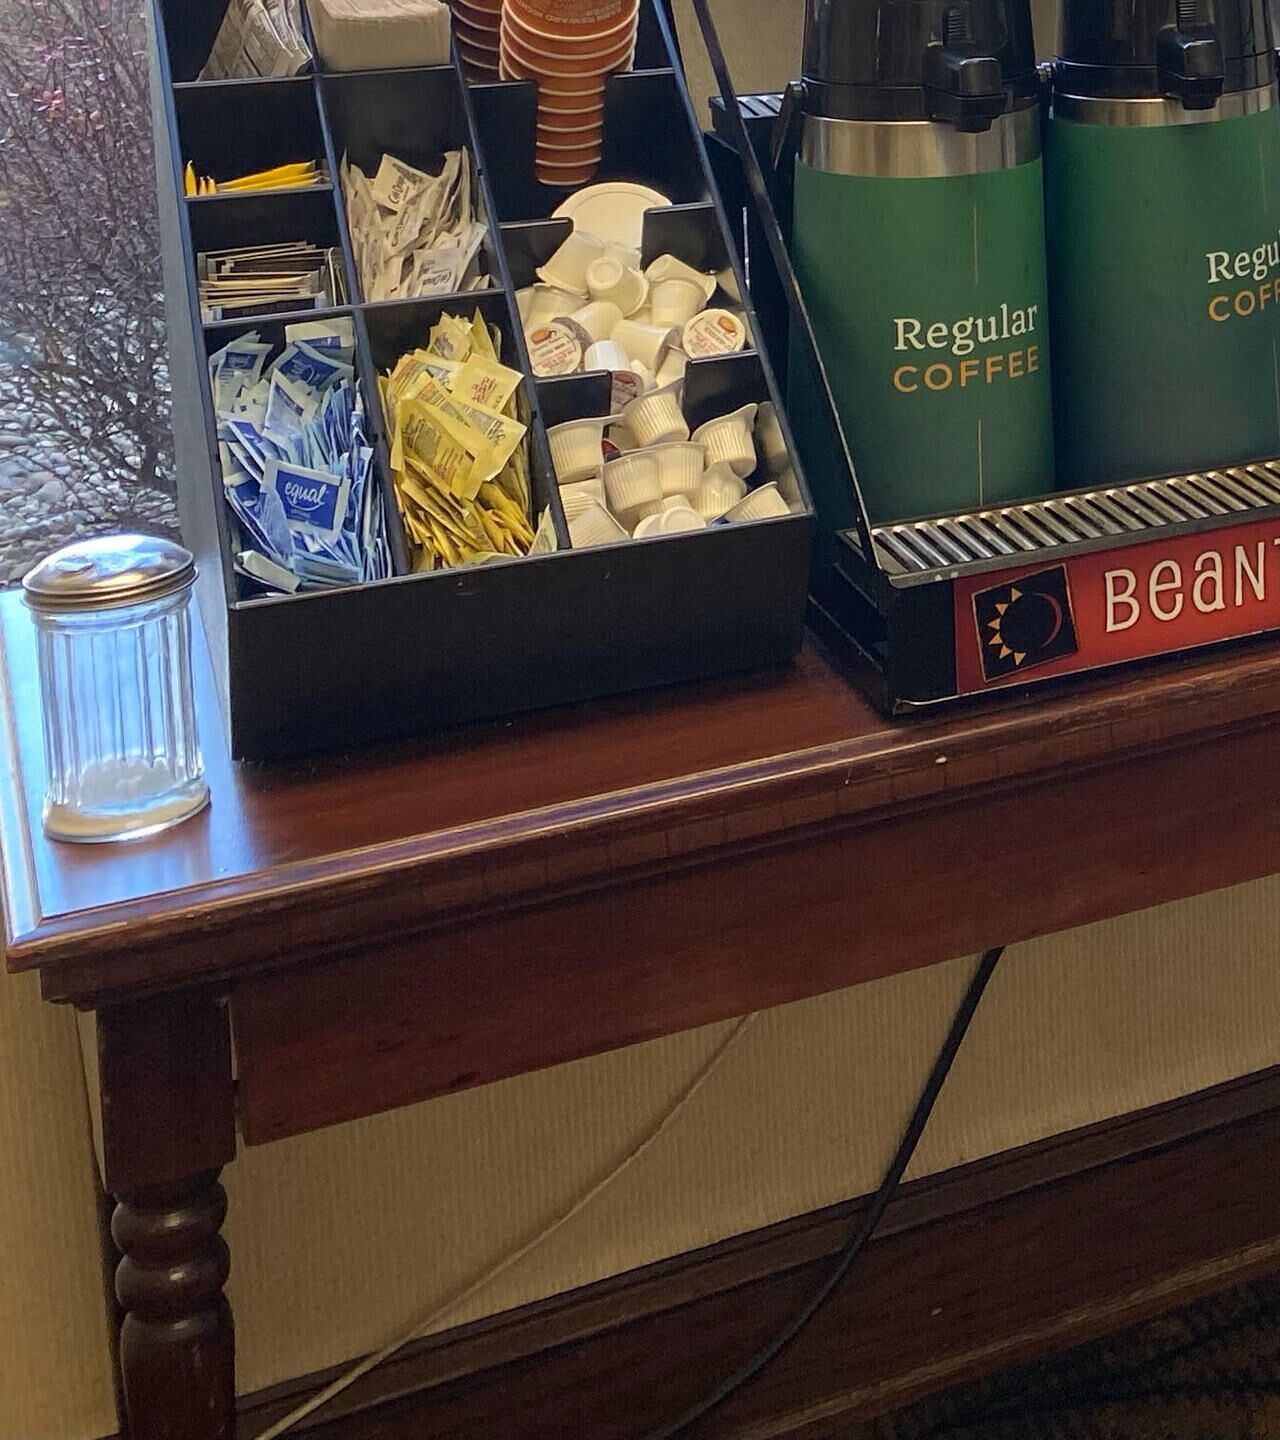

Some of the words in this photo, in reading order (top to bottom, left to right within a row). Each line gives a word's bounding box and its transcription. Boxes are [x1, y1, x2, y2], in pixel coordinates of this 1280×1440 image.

[893, 303, 1038, 356] Regular
[893, 345, 1039, 393] COFFEE
[284, 481, 328, 508] equal
